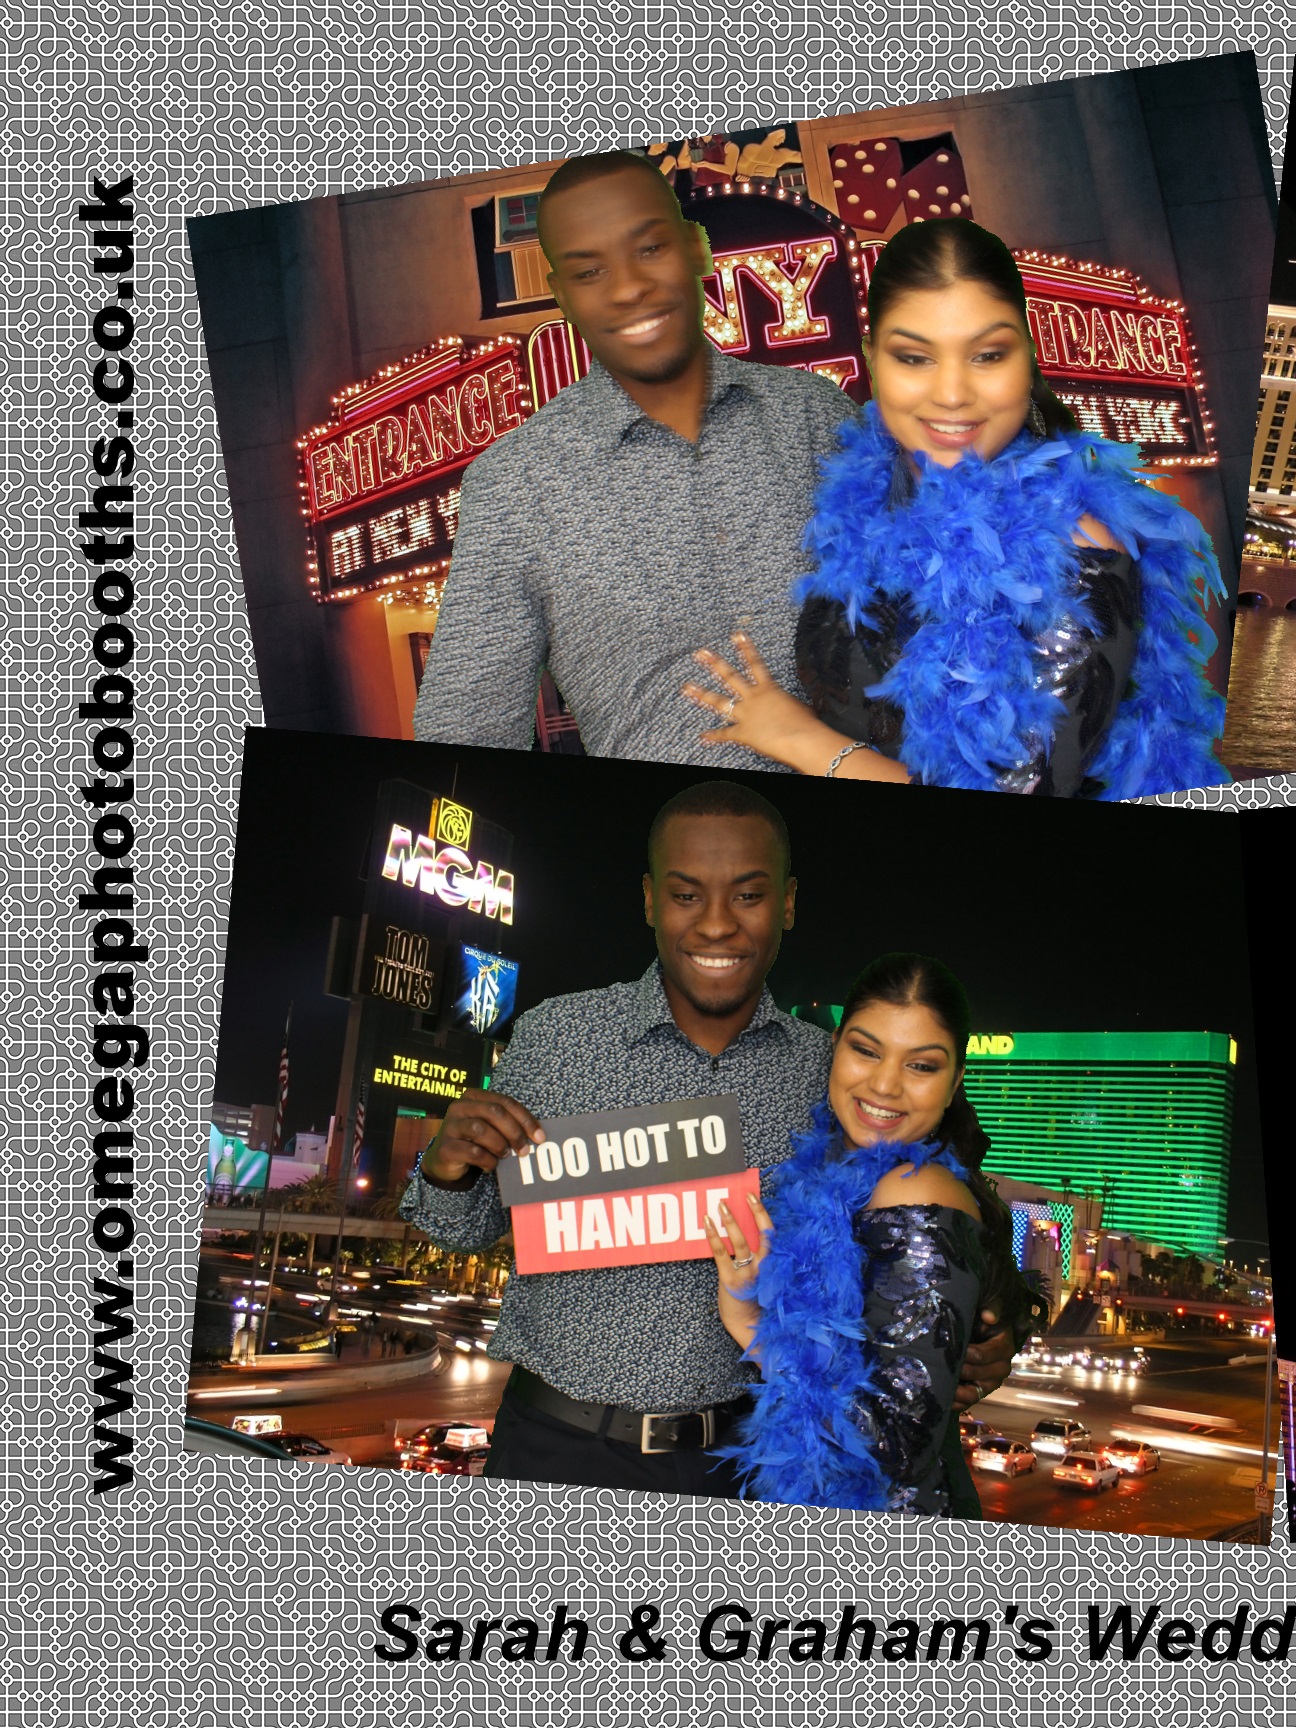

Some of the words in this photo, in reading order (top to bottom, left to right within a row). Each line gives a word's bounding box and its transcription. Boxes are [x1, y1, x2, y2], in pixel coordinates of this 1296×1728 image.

[1026, 297, 1187, 375] TRANCE
[311, 360, 522, 509] ENTRANCE
[382, 823, 514, 926] MGM
[386, 925, 430, 969] TOM
[371, 962, 434, 1010] JONES
[393, 1054, 419, 1073] THE
[420, 1062, 448, 1080] CITY
[449, 1069, 467, 1084] OF
[965, 1035, 1014, 1055] AND
[511, 1137, 590, 1185] TOO
[596, 1123, 670, 1172] HOT
[677, 1115, 727, 1159] TO
[543, 1188, 730, 1254] HANDLE
